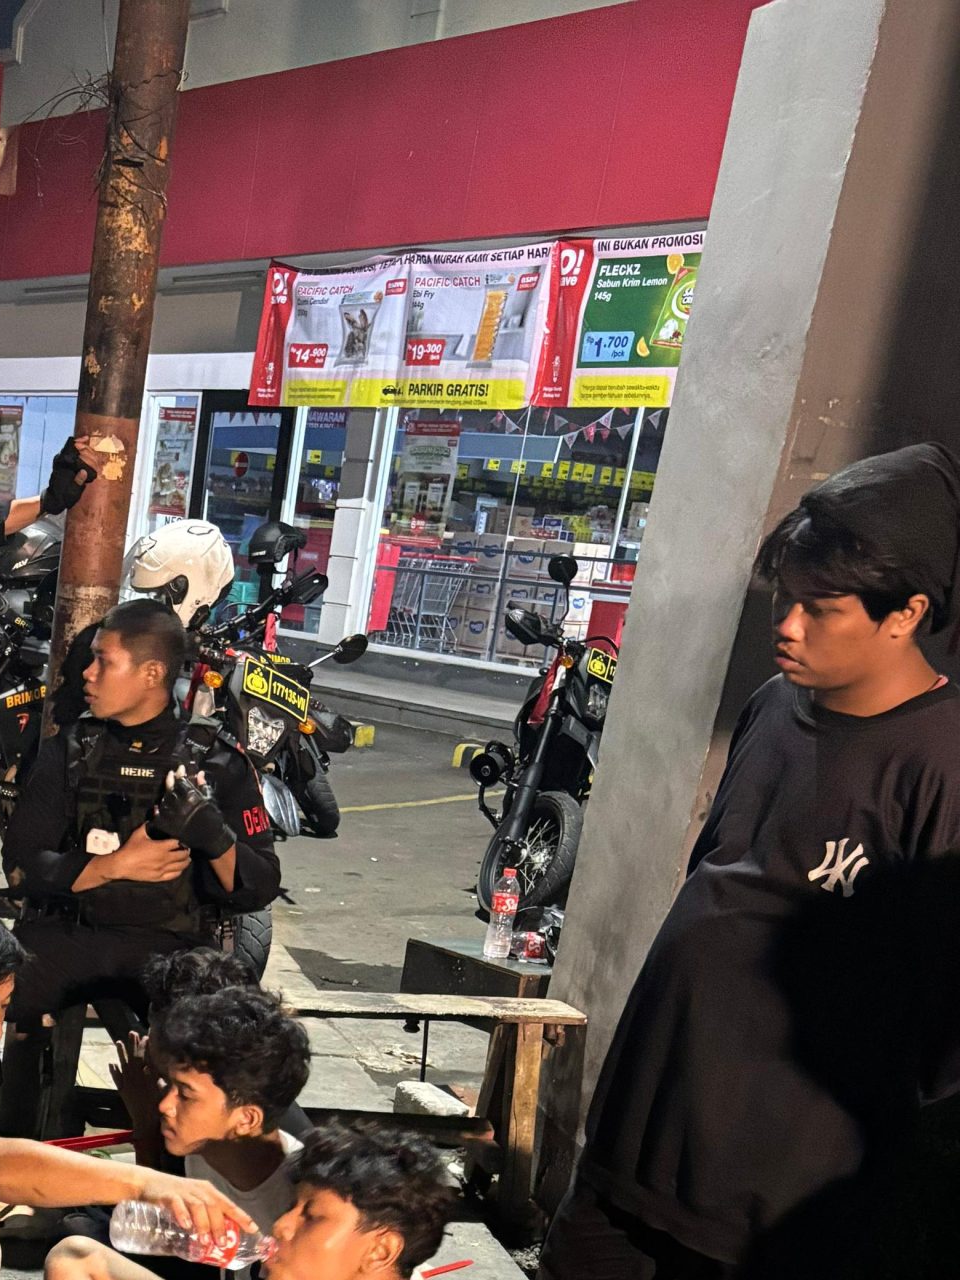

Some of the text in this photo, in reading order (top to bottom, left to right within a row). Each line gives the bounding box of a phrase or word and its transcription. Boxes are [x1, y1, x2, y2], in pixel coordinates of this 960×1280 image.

[597, 241, 611, 253] INI
[613, 237, 651, 251] BUKAN
[404, 252, 432, 266] HARGA
[434, 253, 464, 265] MURAH
[465, 253, 489, 264] KAMI
[490, 249, 525, 263] SETIAP
[599, 263, 641, 277] FLECKZ
[414, 276, 451, 287] PACIFIC
[452, 275, 481, 287] CATCH
[560, 276, 577, 287] ave
[596, 277, 668, 289] Sabun Krim Lemon
[297, 285, 354, 297] PACIFIC CATCH
[423, 290, 435, 300] Fry
[594, 291, 612, 303] 145g
[412, 343, 443, 361] 19.300
[595, 335, 629, 358] 1.700
[407, 383, 490, 397] PARKIR GRATIS!
[120, 766, 156, 779] RERE
